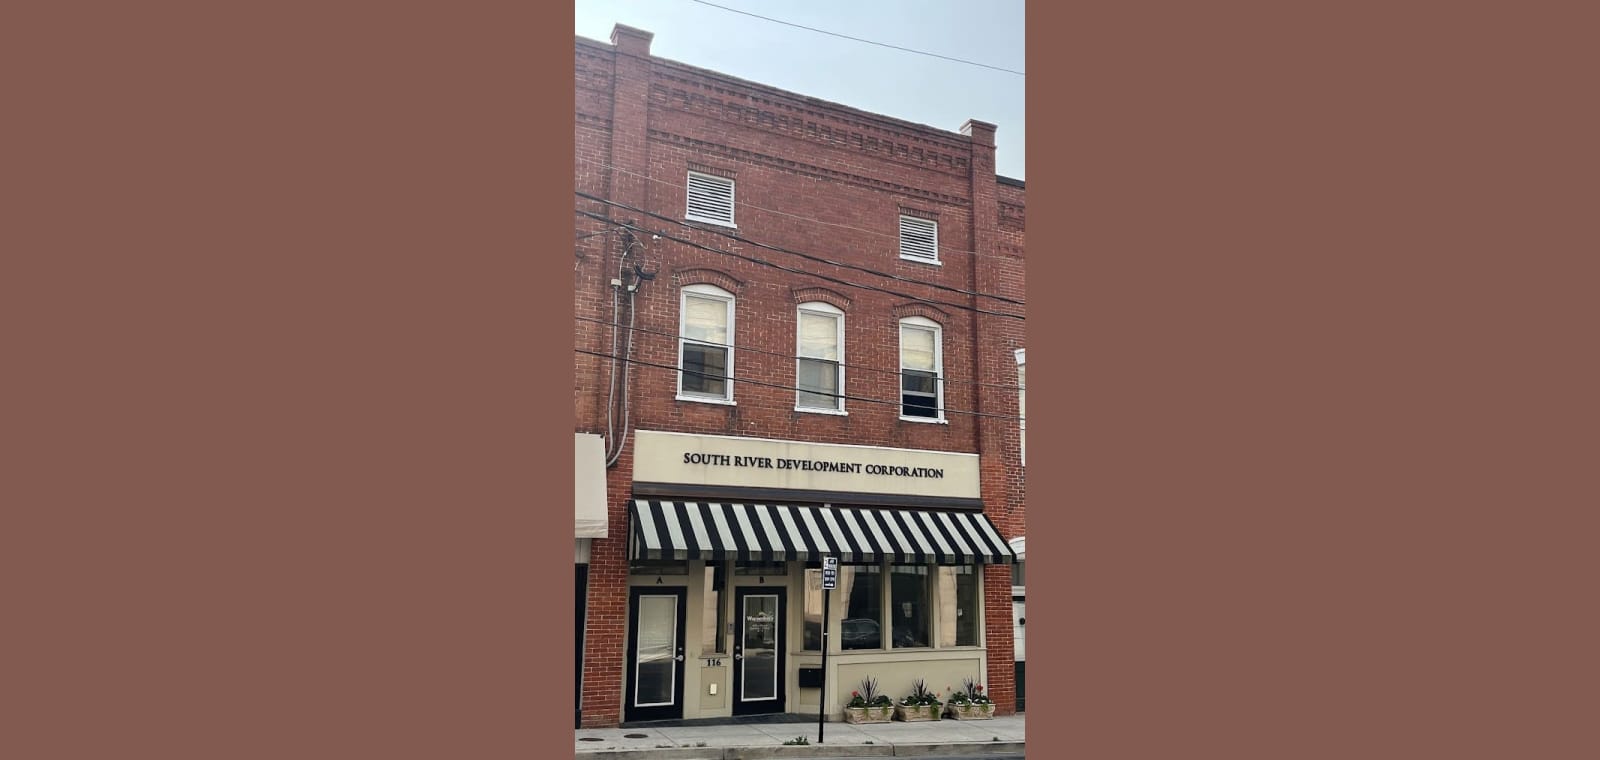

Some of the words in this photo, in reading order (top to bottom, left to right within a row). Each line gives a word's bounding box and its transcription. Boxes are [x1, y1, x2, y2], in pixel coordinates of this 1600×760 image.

[683, 452, 730, 466] SOUTH
[734, 455, 773, 469] RIVER
[776, 458, 862, 474] DEVELOPMENT
[865, 464, 944, 479] CORPORATION
[656, 576, 663, 584] A
[759, 576, 765, 584] B
[707, 658, 721, 667] 116
